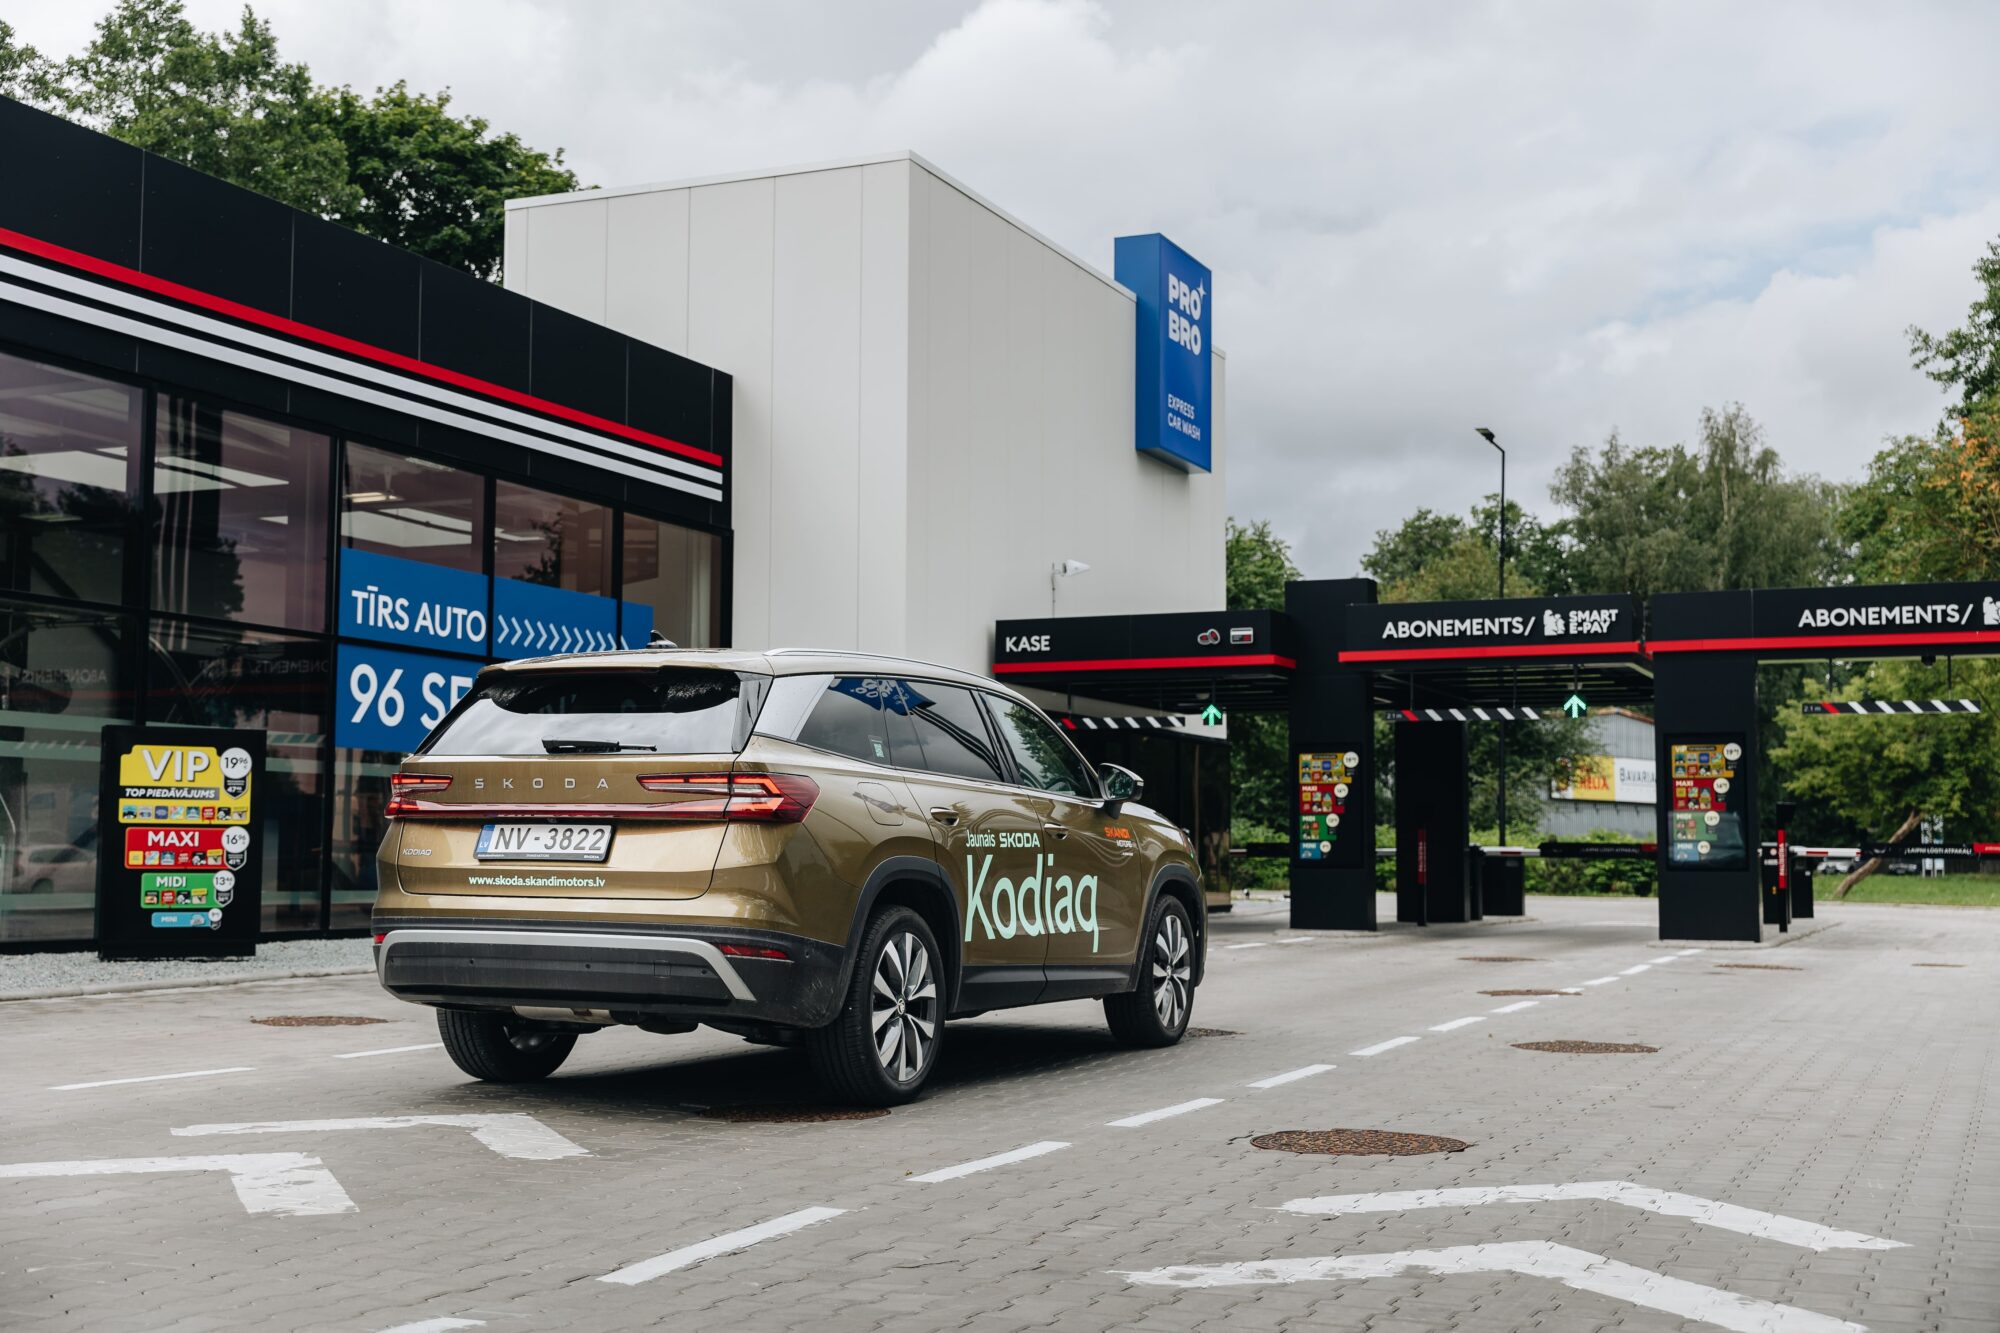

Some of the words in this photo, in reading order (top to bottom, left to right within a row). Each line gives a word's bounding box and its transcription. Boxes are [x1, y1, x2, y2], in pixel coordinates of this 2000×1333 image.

[1168, 272, 1201, 320] PRO
[1168, 309, 1201, 355] BRO
[1168, 394, 1195, 419] EXPRESS
[1168, 412, 1181, 431] CAR
[1182, 420, 1200, 441] WASH
[351, 585, 410, 632] TĪRS
[414, 602, 487, 642] AUTO
[1569, 609, 1619, 622] SMART
[1569, 621, 1610, 634] E-PAY
[1005, 635, 1051, 652] KASE
[350, 664, 405, 727] 96
[141, 749, 210, 782] VIP
[125, 787, 146, 797] TOP
[146, 787, 215, 799] PIEDĀVĀJUMS
[147, 831, 199, 847] MAXI
[965, 829, 996, 848] Jaunais
[156, 876, 187, 888] MIDI
[469, 875, 606, 888] www.skoda.skandimotors.lv
[964, 853, 1099, 953] Kodiaq
[161, 915, 178, 923] MINI
